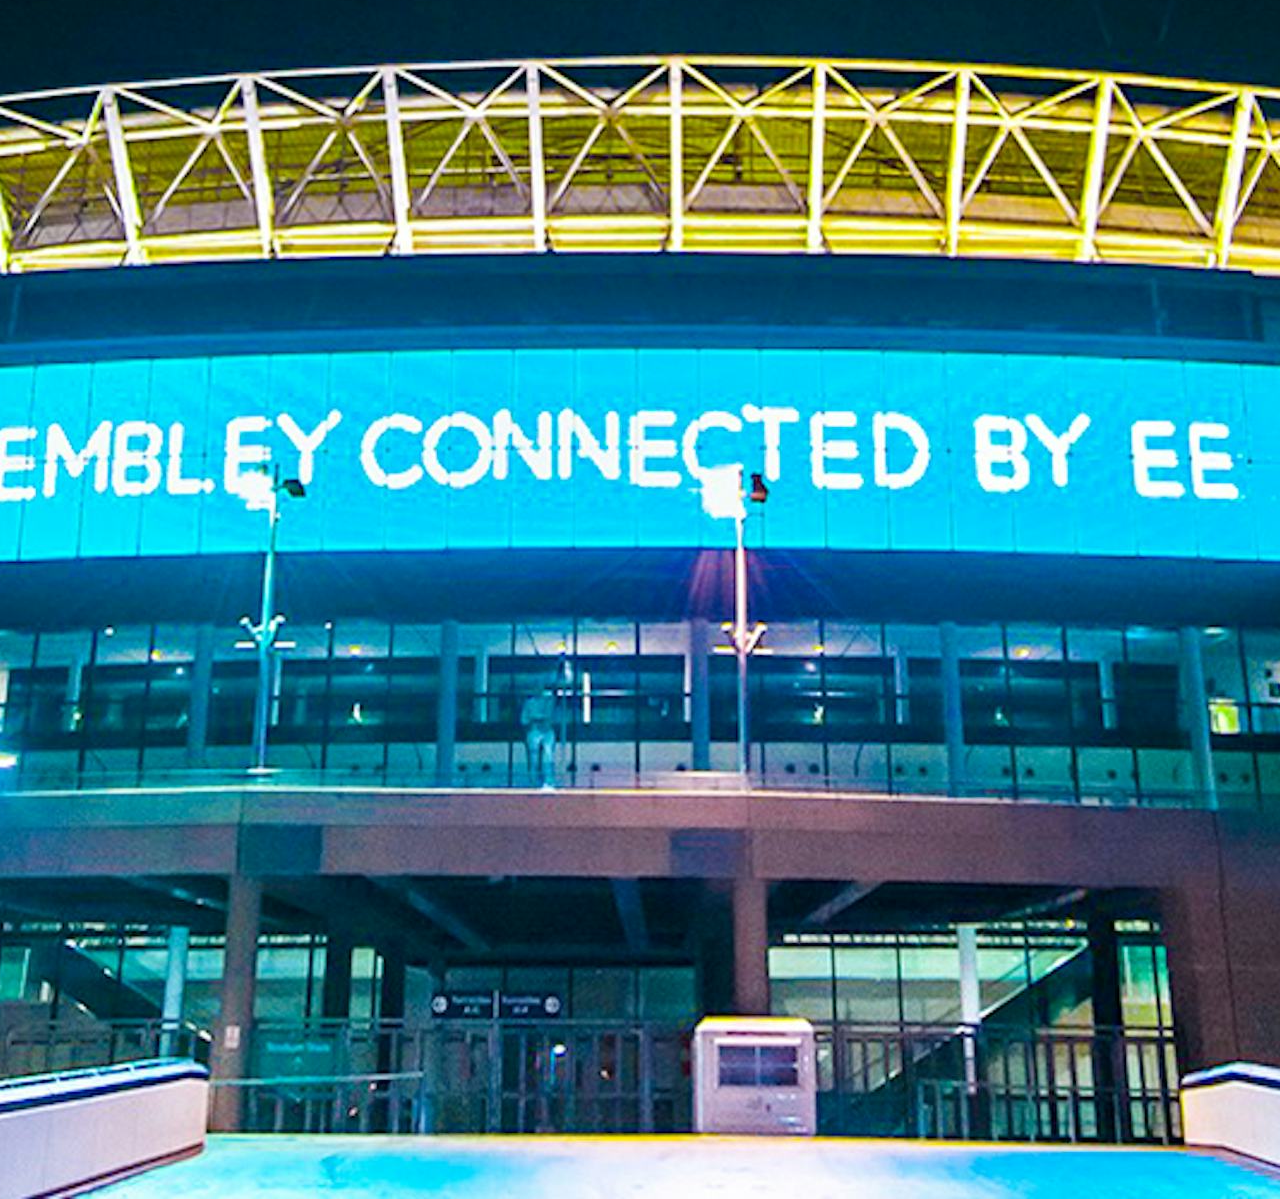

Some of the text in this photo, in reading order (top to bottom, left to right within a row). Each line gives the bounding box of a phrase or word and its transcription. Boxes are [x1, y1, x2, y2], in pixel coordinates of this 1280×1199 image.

[360, 403, 931, 491] CONNECTED
[973, 413, 1091, 493] BY
[1131, 420, 1239, 500] EE
